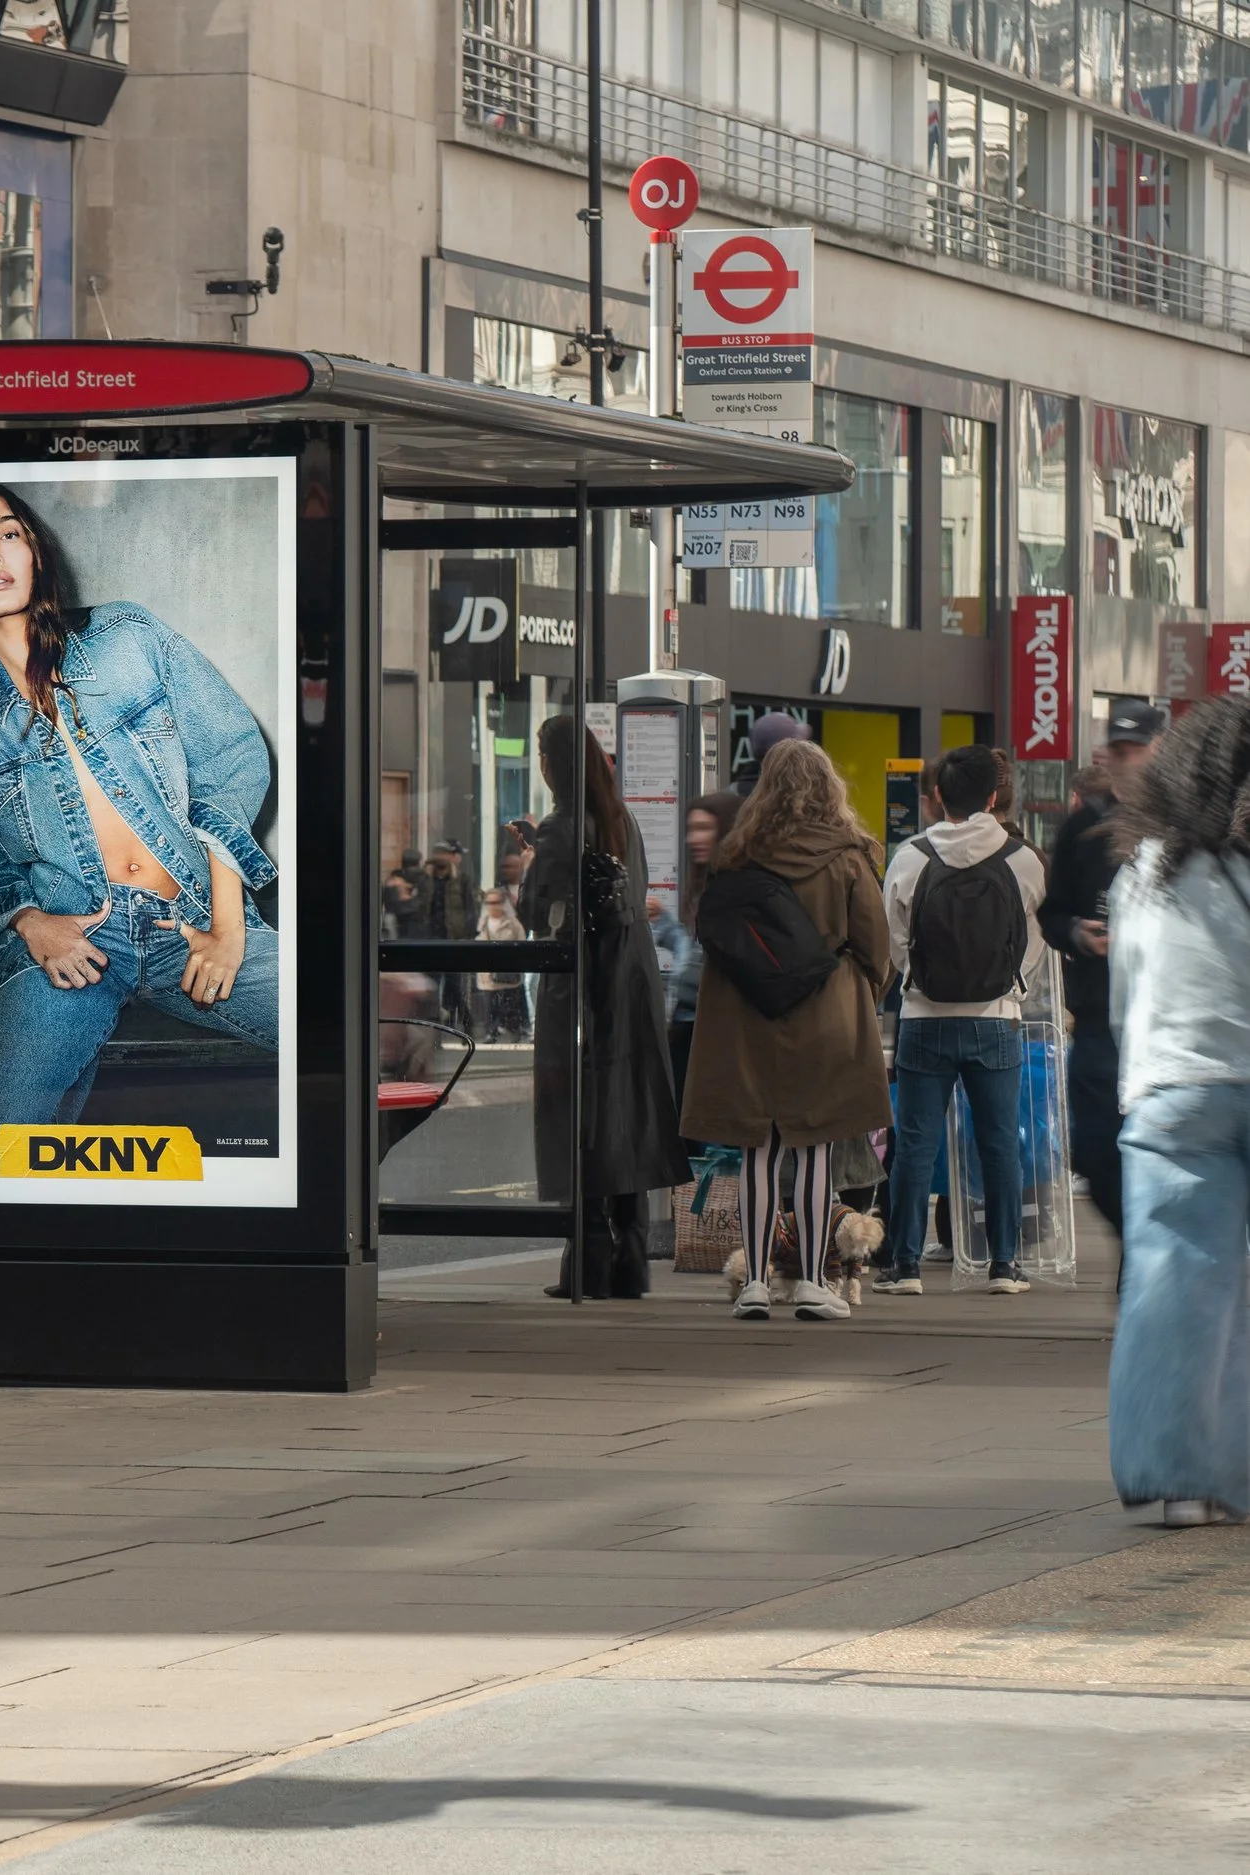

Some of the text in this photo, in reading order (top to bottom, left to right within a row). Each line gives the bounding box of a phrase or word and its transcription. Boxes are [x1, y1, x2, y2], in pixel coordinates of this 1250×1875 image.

[641, 178, 686, 209] OJ
[721, 335, 771, 345] BUS STOP
[686, 352, 806, 365] Great Titchfield Street
[699, 365, 782, 377] Oxford Circus Station
[76, 370, 136, 387] Street
[711, 392, 782, 402] towards Holborn
[726, 405, 751, 414] King's
[753, 404, 778, 413] Cross
[781, 431, 799, 443] 98
[49, 437, 140, 454] JCDecaux
[688, 506, 718, 519] N55
[731, 504, 761, 518] N73
[774, 504, 805, 518] N98
[683, 541, 722, 556] N207
[443, 596, 509, 645] JD
[519, 615, 575, 646] PORTS.CO
[820, 628, 850, 695] JD
[244, 1138, 269, 1146] BIEBER
[29, 1136, 170, 1172] DKNY
